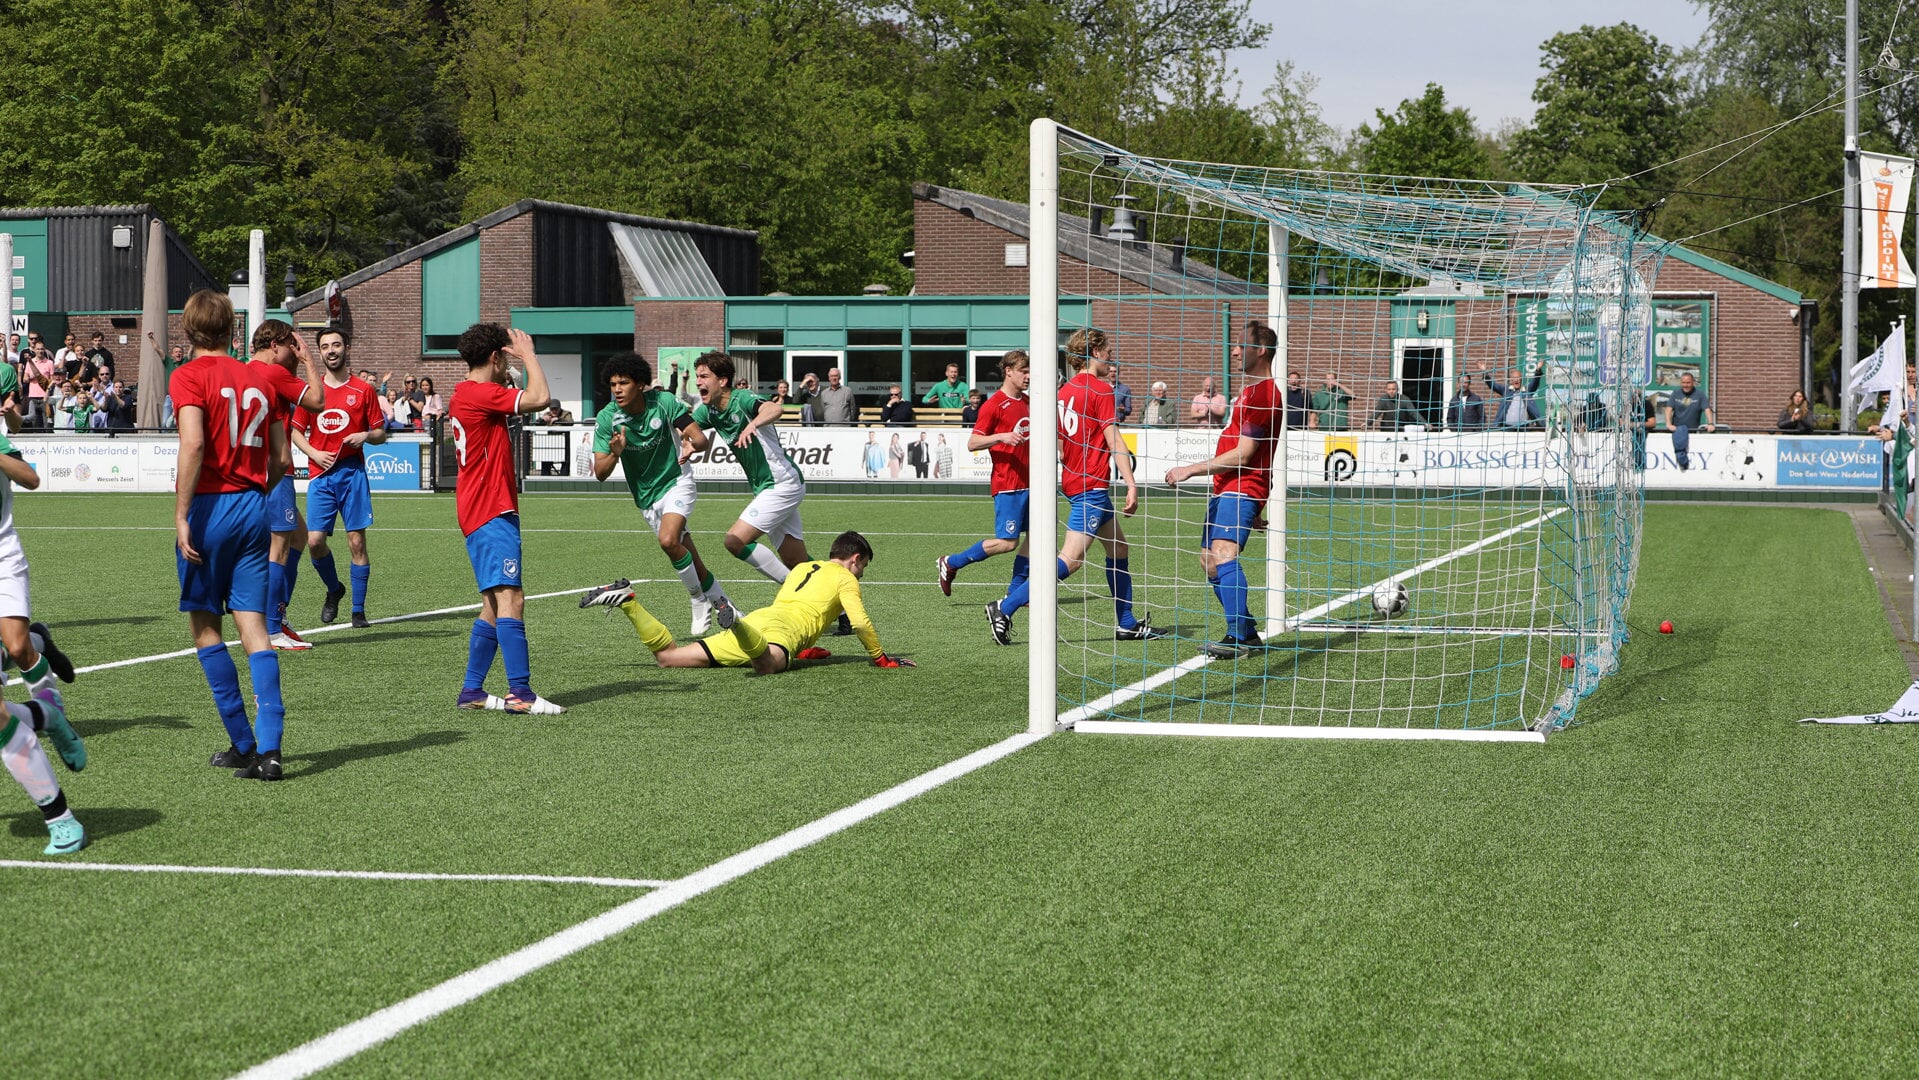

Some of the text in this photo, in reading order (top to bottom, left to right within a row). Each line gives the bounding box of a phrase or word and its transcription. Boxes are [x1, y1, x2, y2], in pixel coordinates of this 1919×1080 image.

[220, 387, 268, 448] 12
[78, 446, 130, 455] Nederland
[154, 445, 177, 455] Deze
[809, 468, 834, 476] Zeist
[1842, 470, 1878, 479] Nederland
[795, 564, 821, 592] 1
